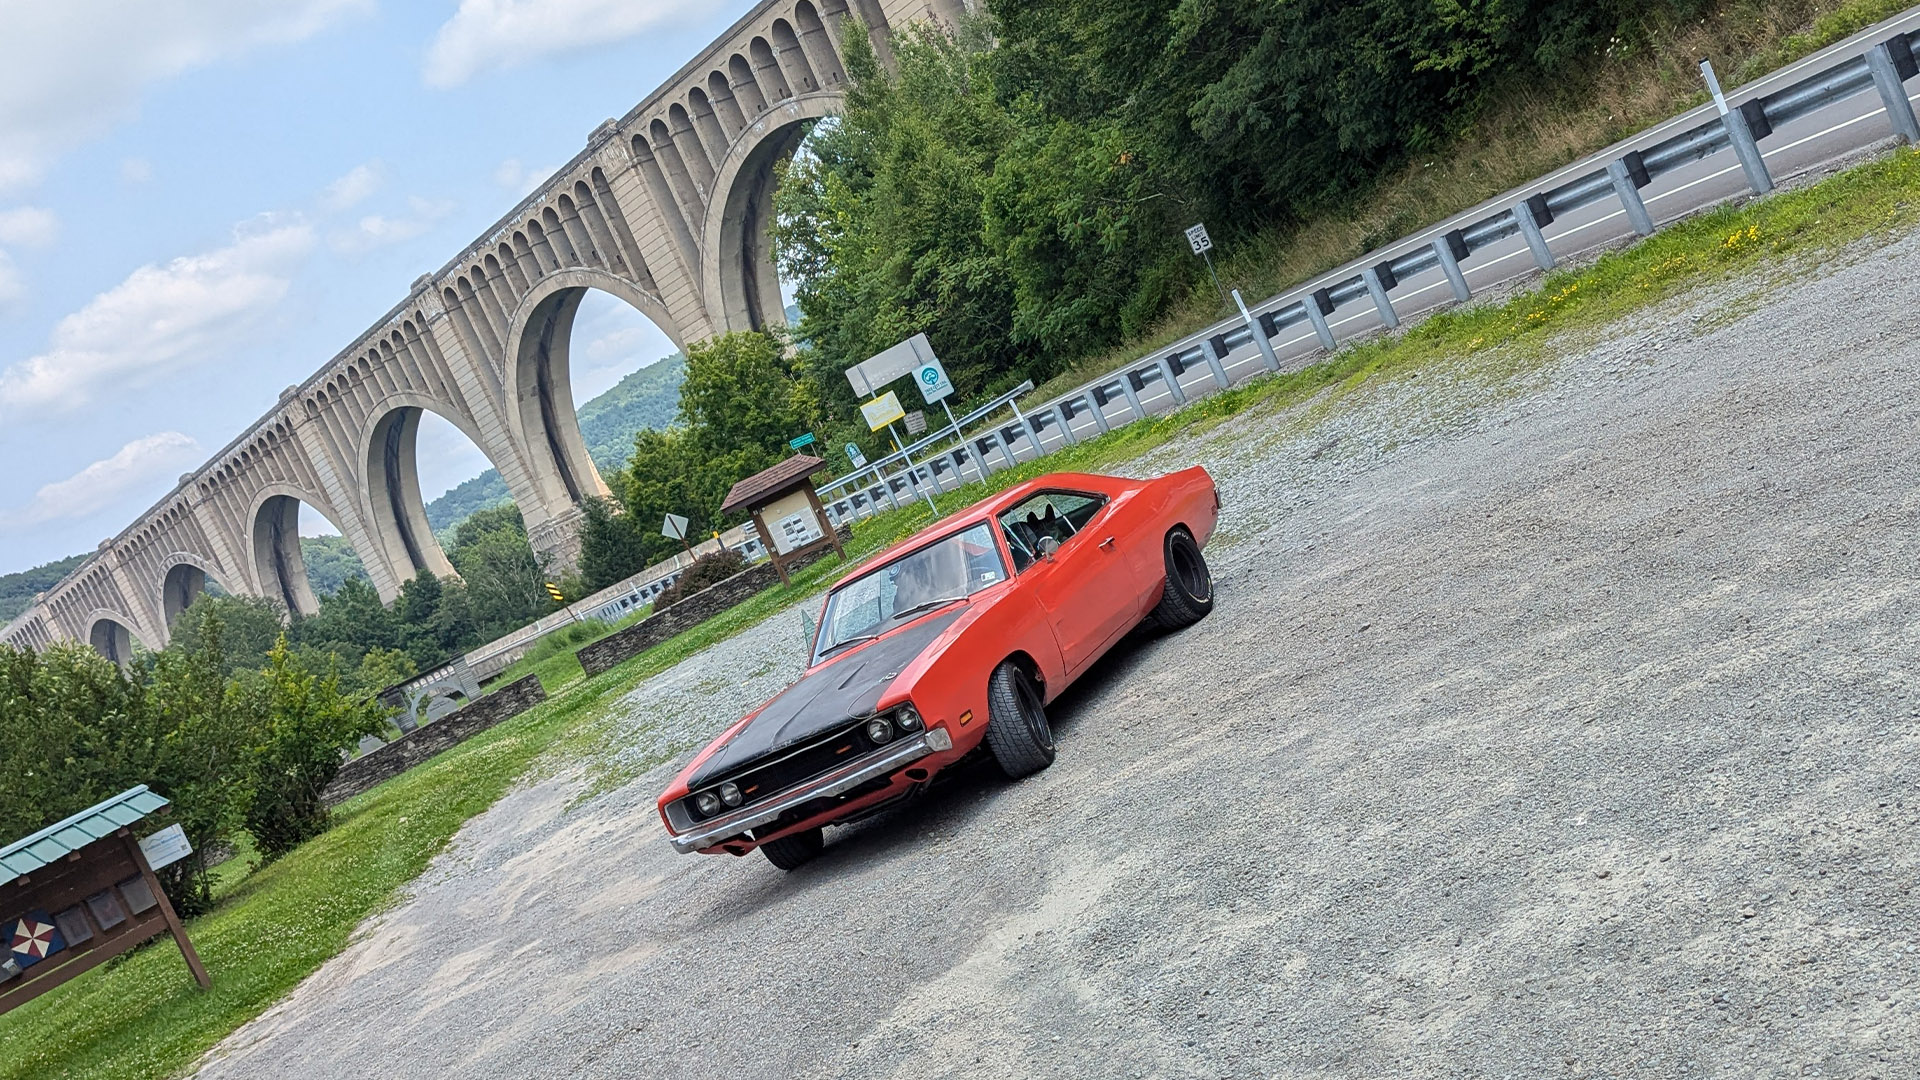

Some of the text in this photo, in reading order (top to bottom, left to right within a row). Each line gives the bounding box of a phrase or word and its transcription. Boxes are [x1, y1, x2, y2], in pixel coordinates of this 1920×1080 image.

[1187, 225, 1203, 236] SPEED
[1191, 231, 1203, 240] LIMIT
[1192, 236, 1209, 250] 35
